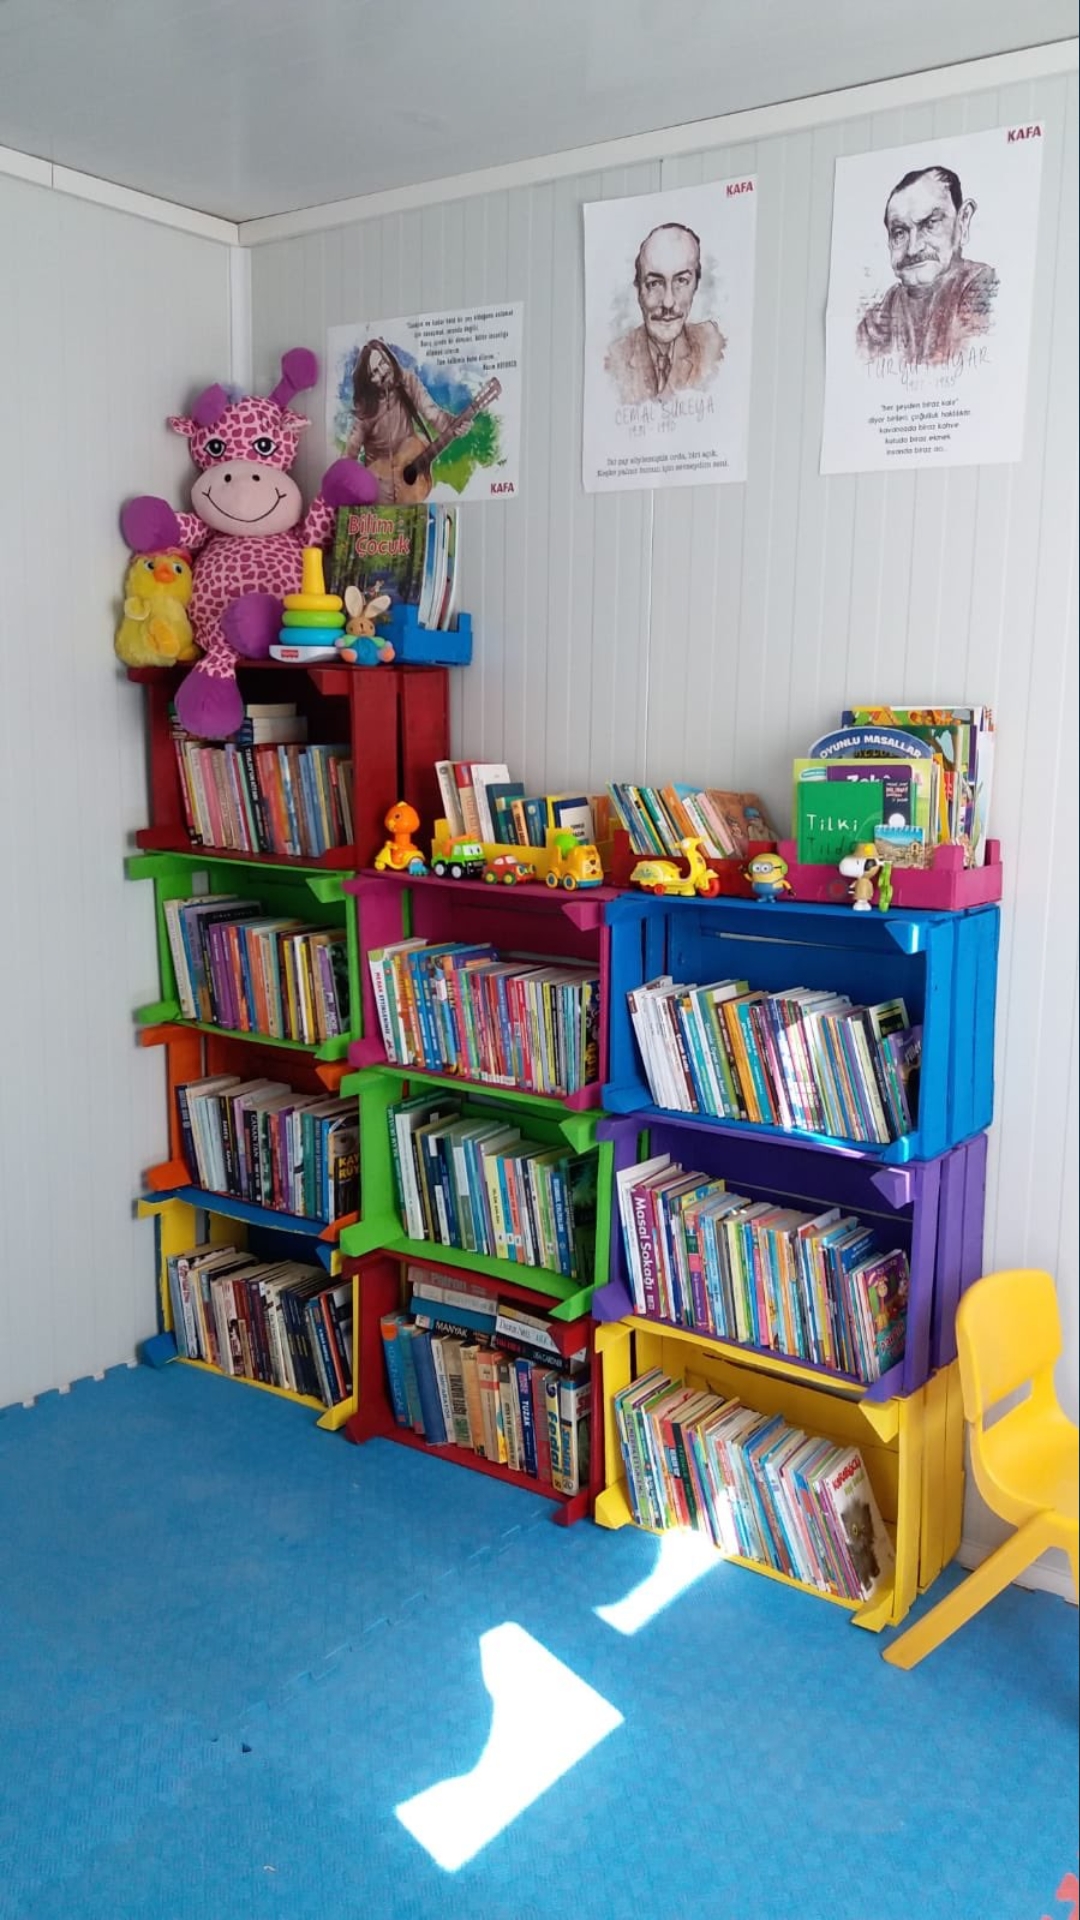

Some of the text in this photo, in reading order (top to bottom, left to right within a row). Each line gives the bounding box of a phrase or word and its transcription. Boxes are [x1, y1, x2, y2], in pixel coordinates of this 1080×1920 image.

[1006, 125, 1042, 143] KAFA
[725, 180, 754, 197] KAFA
[490, 482, 515, 494] KAFA
[348, 513, 395, 535] Bilim
[354, 532, 411, 558] Çocuk
[819, 735, 922, 758] OYUNLU MASALLAR
[806, 813, 858, 831] Tilki
[634, 1195, 650, 1240] Masal
[641, 1241, 655, 1291] Sokağı
[435, 1320, 469, 1338] MANYAK
[522, 1400, 531, 1427] TUZAK
